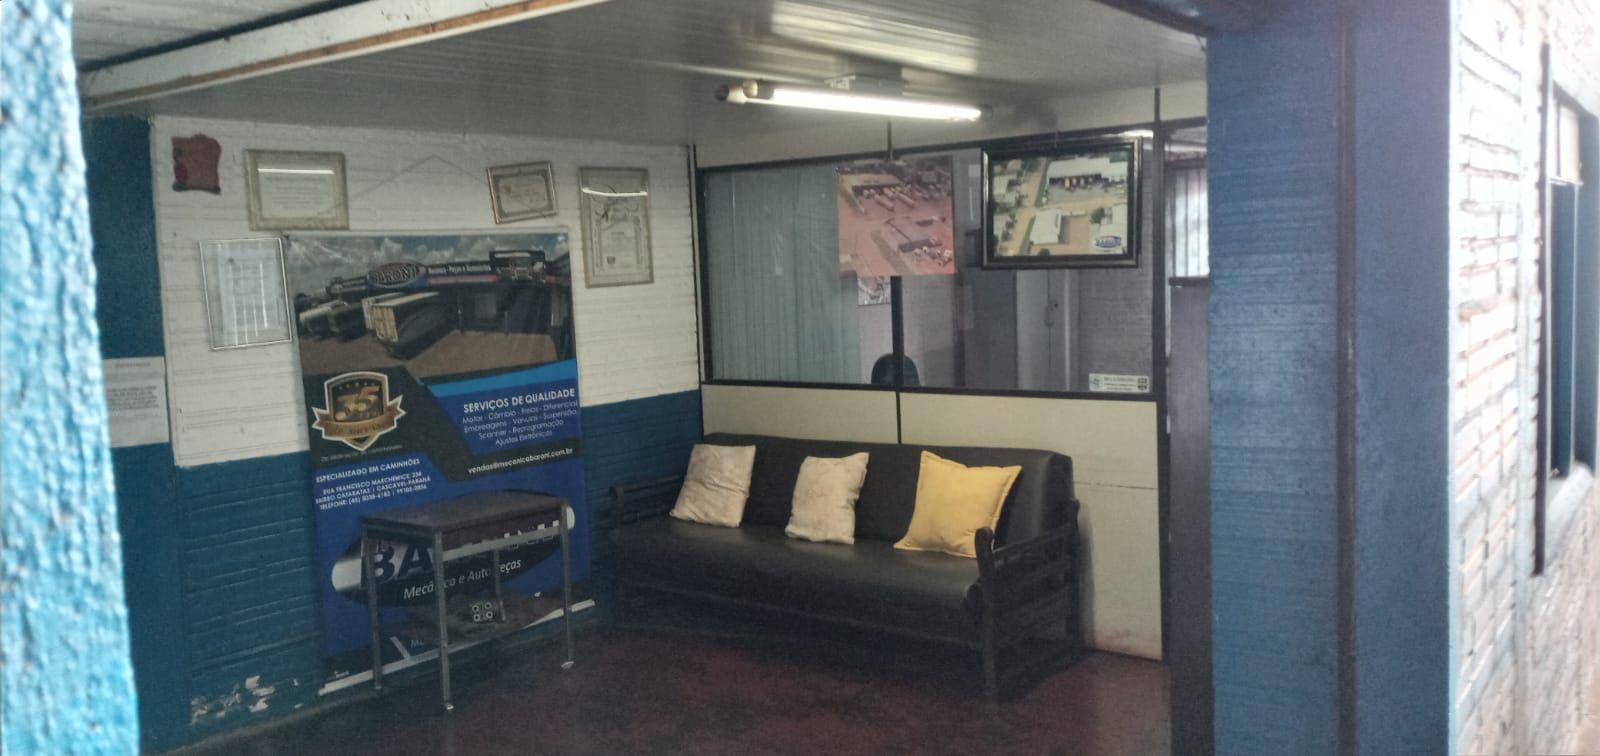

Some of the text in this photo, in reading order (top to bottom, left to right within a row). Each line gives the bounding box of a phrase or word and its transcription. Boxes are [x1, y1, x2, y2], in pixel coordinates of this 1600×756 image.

[463, 388, 575, 413] SERVIÇOS DE QUALIDADE
[462, 415, 483, 424] Motor
[488, 409, 516, 420] Câmbio
[543, 408, 577, 421] Suspensão
[478, 419, 564, 440] Scanner Reprogramação
[316, 458, 420, 483] ESPECIALIZADO EM CAMINHÕES
[335, 481, 370, 492] FRANCISCO
[336, 489, 370, 499] CATARATAS
[403, 579, 456, 599] Mecâca
[458, 575, 465, 584] e
[500, 559, 521, 574] eças
